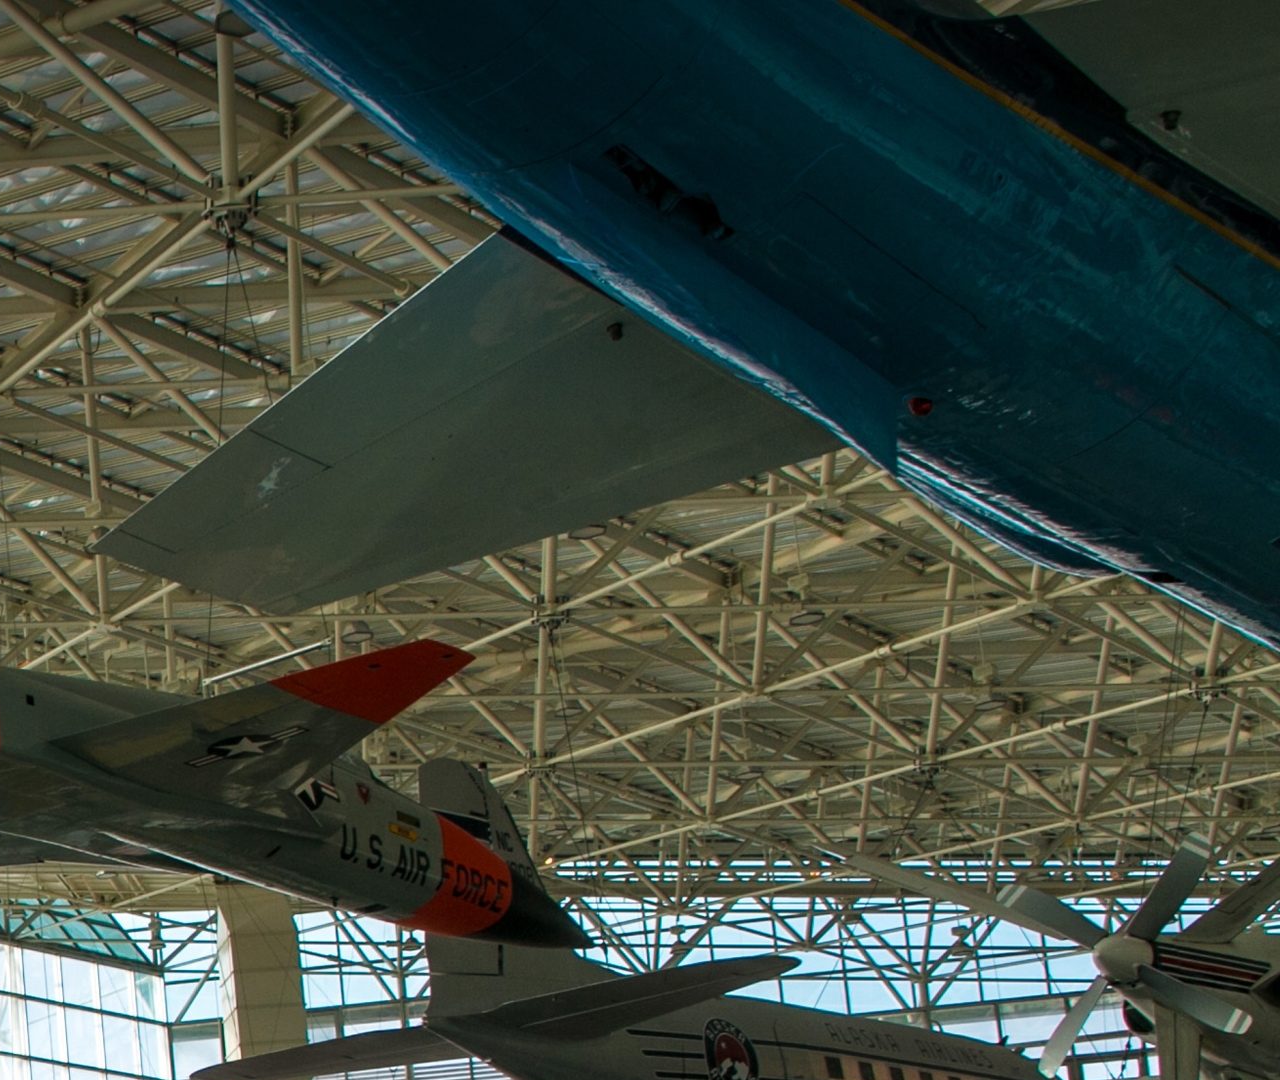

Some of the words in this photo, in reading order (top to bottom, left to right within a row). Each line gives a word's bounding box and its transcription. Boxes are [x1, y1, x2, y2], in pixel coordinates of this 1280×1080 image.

[392, 845, 430, 886] AIR
[435, 858, 508, 914] FORCE
[825, 1022, 901, 1053] ALASKA
[915, 1038, 995, 1069] AIRLINES
